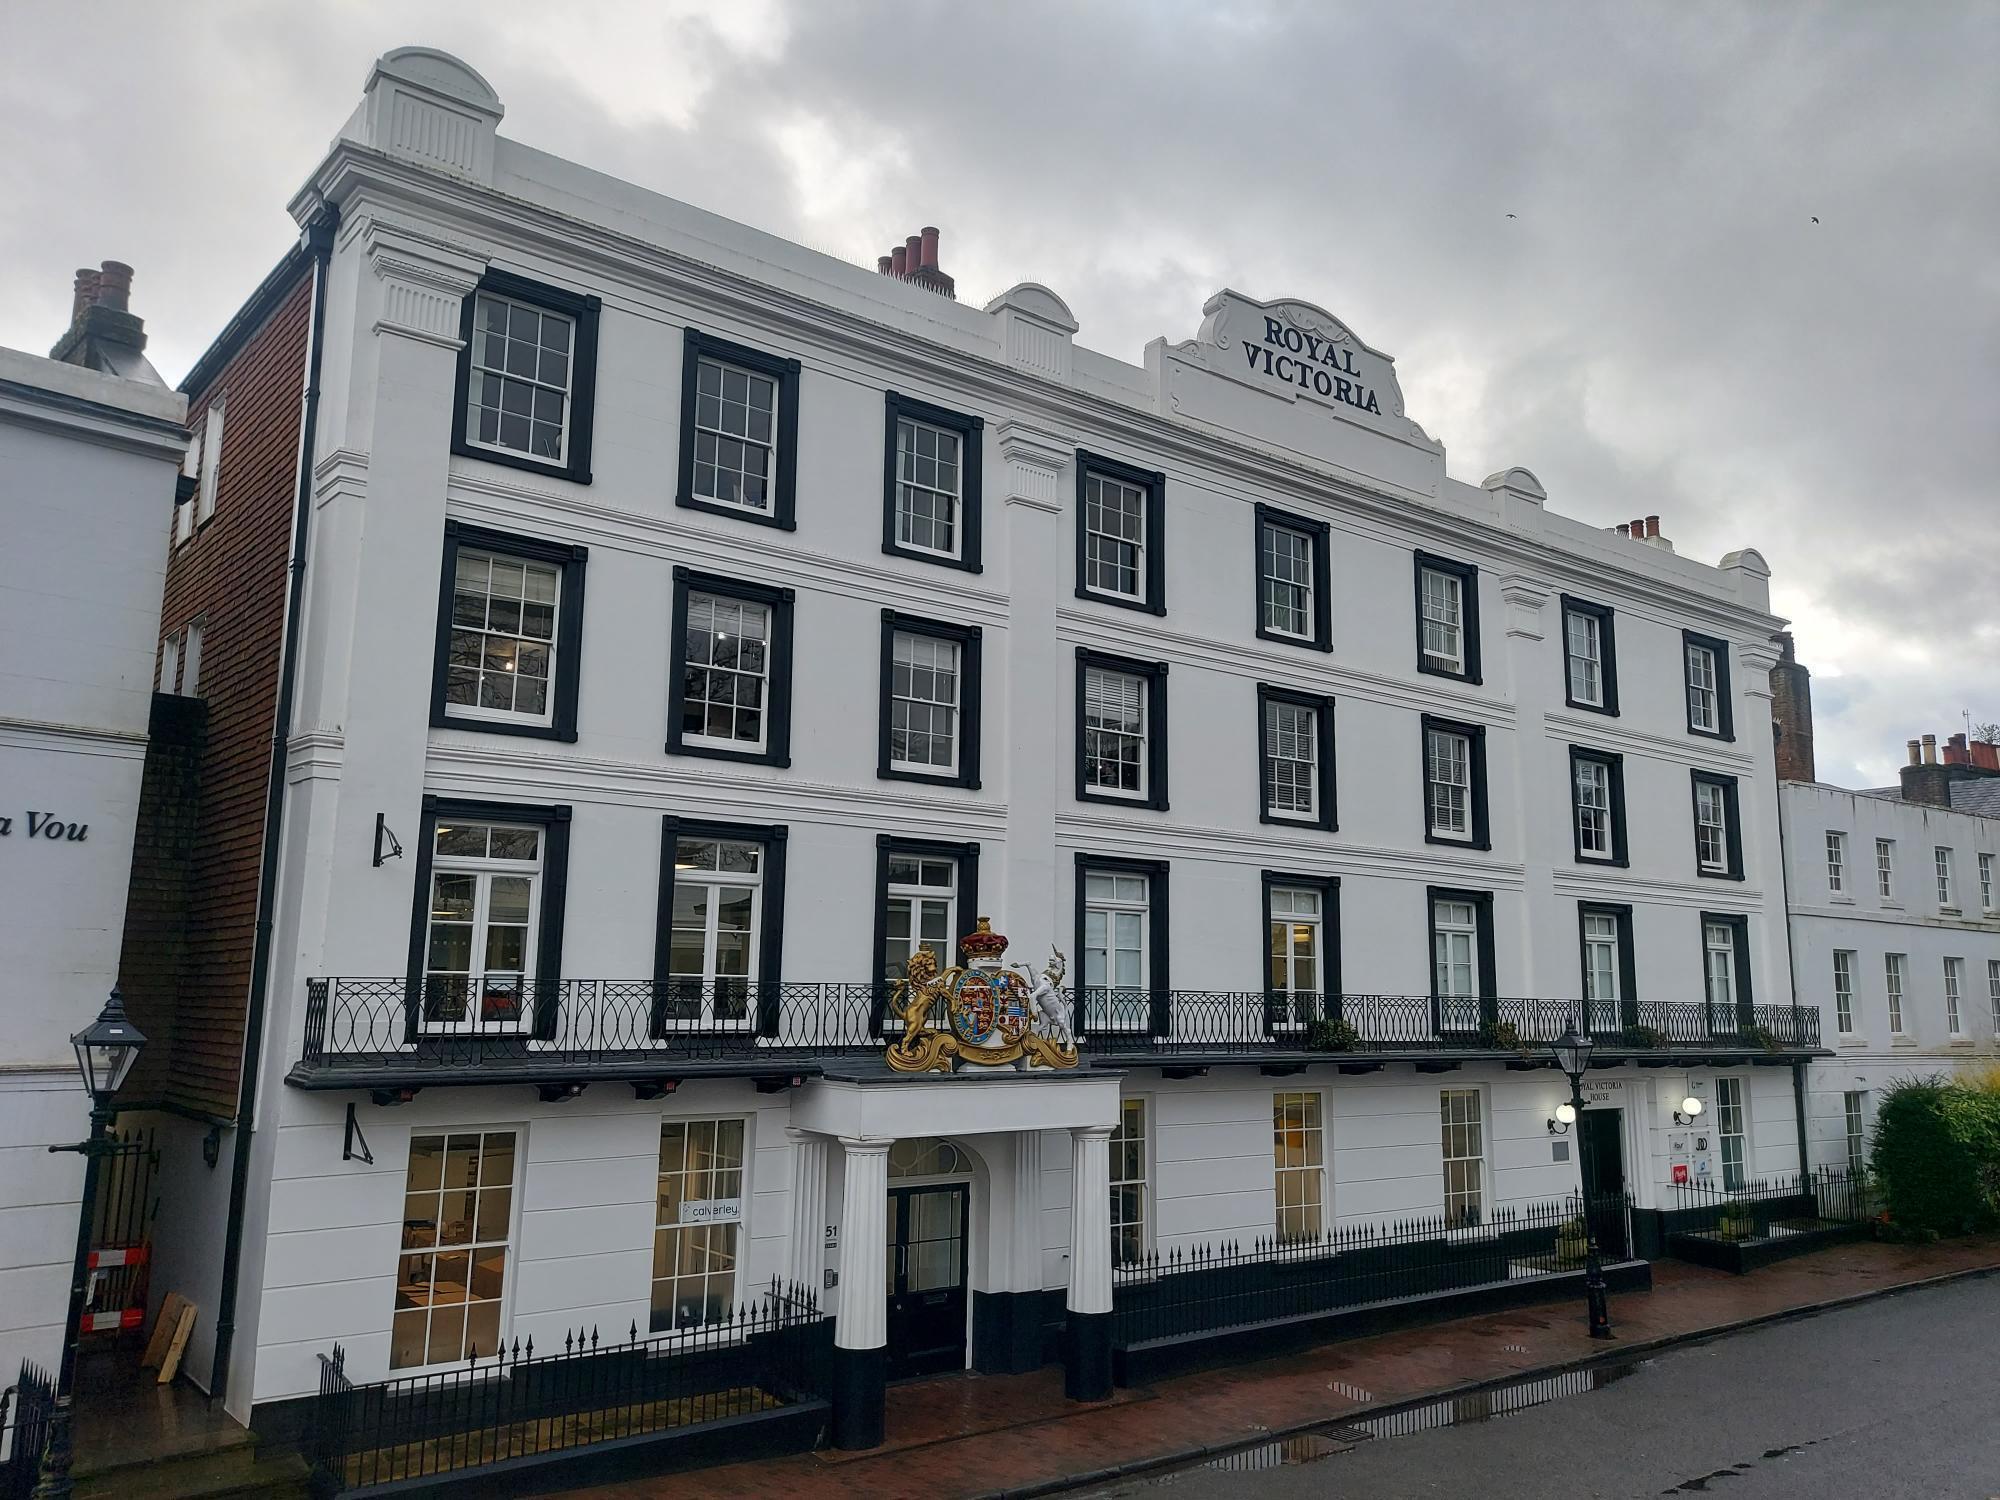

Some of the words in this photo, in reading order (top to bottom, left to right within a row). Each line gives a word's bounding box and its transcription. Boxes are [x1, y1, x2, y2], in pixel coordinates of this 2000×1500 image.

[1264, 315, 1361, 378] ROYAL
[1242, 340, 1382, 416] VICTORIA
[26, 810, 89, 842] Vou
[1580, 1082, 1594, 1090] OYAL
[1595, 1081, 1623, 1090] VICTORIA
[1590, 1092, 1610, 1101] HOUSE
[825, 1225, 837, 1237] 51
